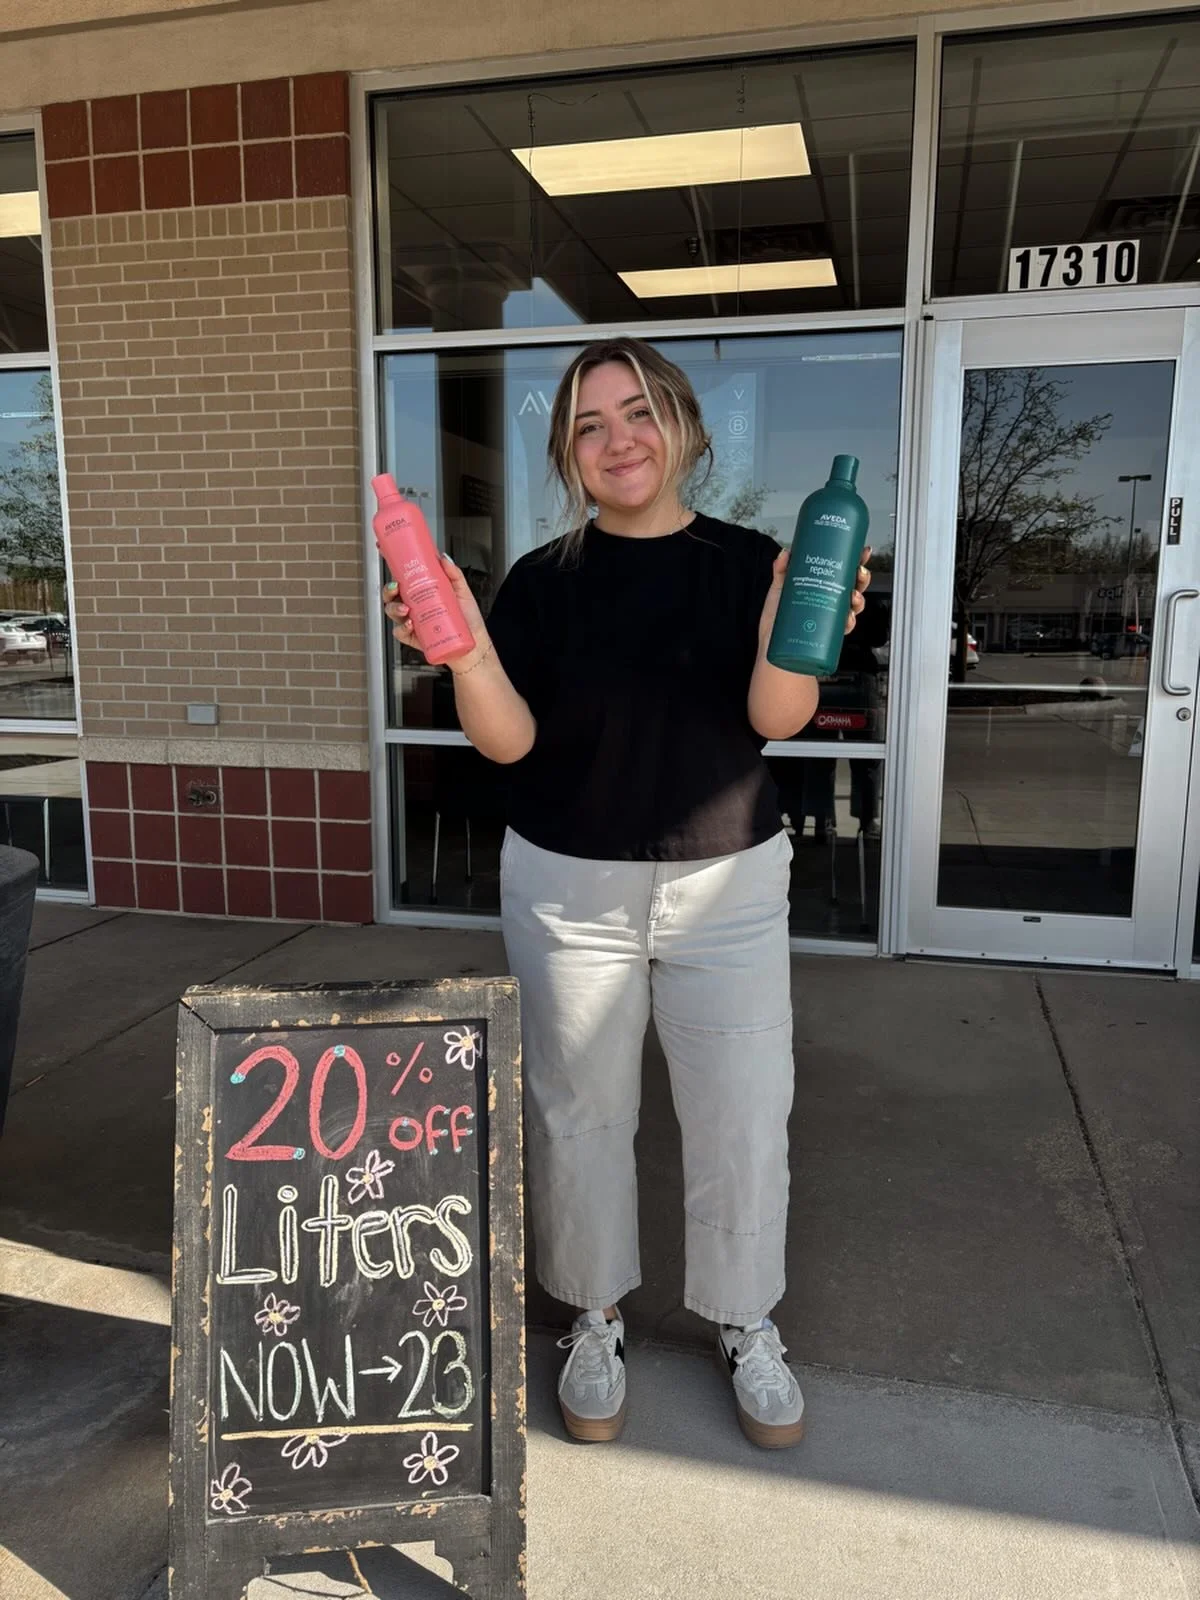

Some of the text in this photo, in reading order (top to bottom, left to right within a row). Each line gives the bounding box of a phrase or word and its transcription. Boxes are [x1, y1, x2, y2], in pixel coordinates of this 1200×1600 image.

[1015, 241, 1137, 289] 17310
[384, 518, 406, 531] AVEDA
[820, 513, 847, 524] AVEDA
[1169, 498, 1181, 536] PULL
[805, 554, 843, 570] botanical
[216, 1174, 473, 1288] Liters
[220, 1330, 475, 1423] NOW 23
